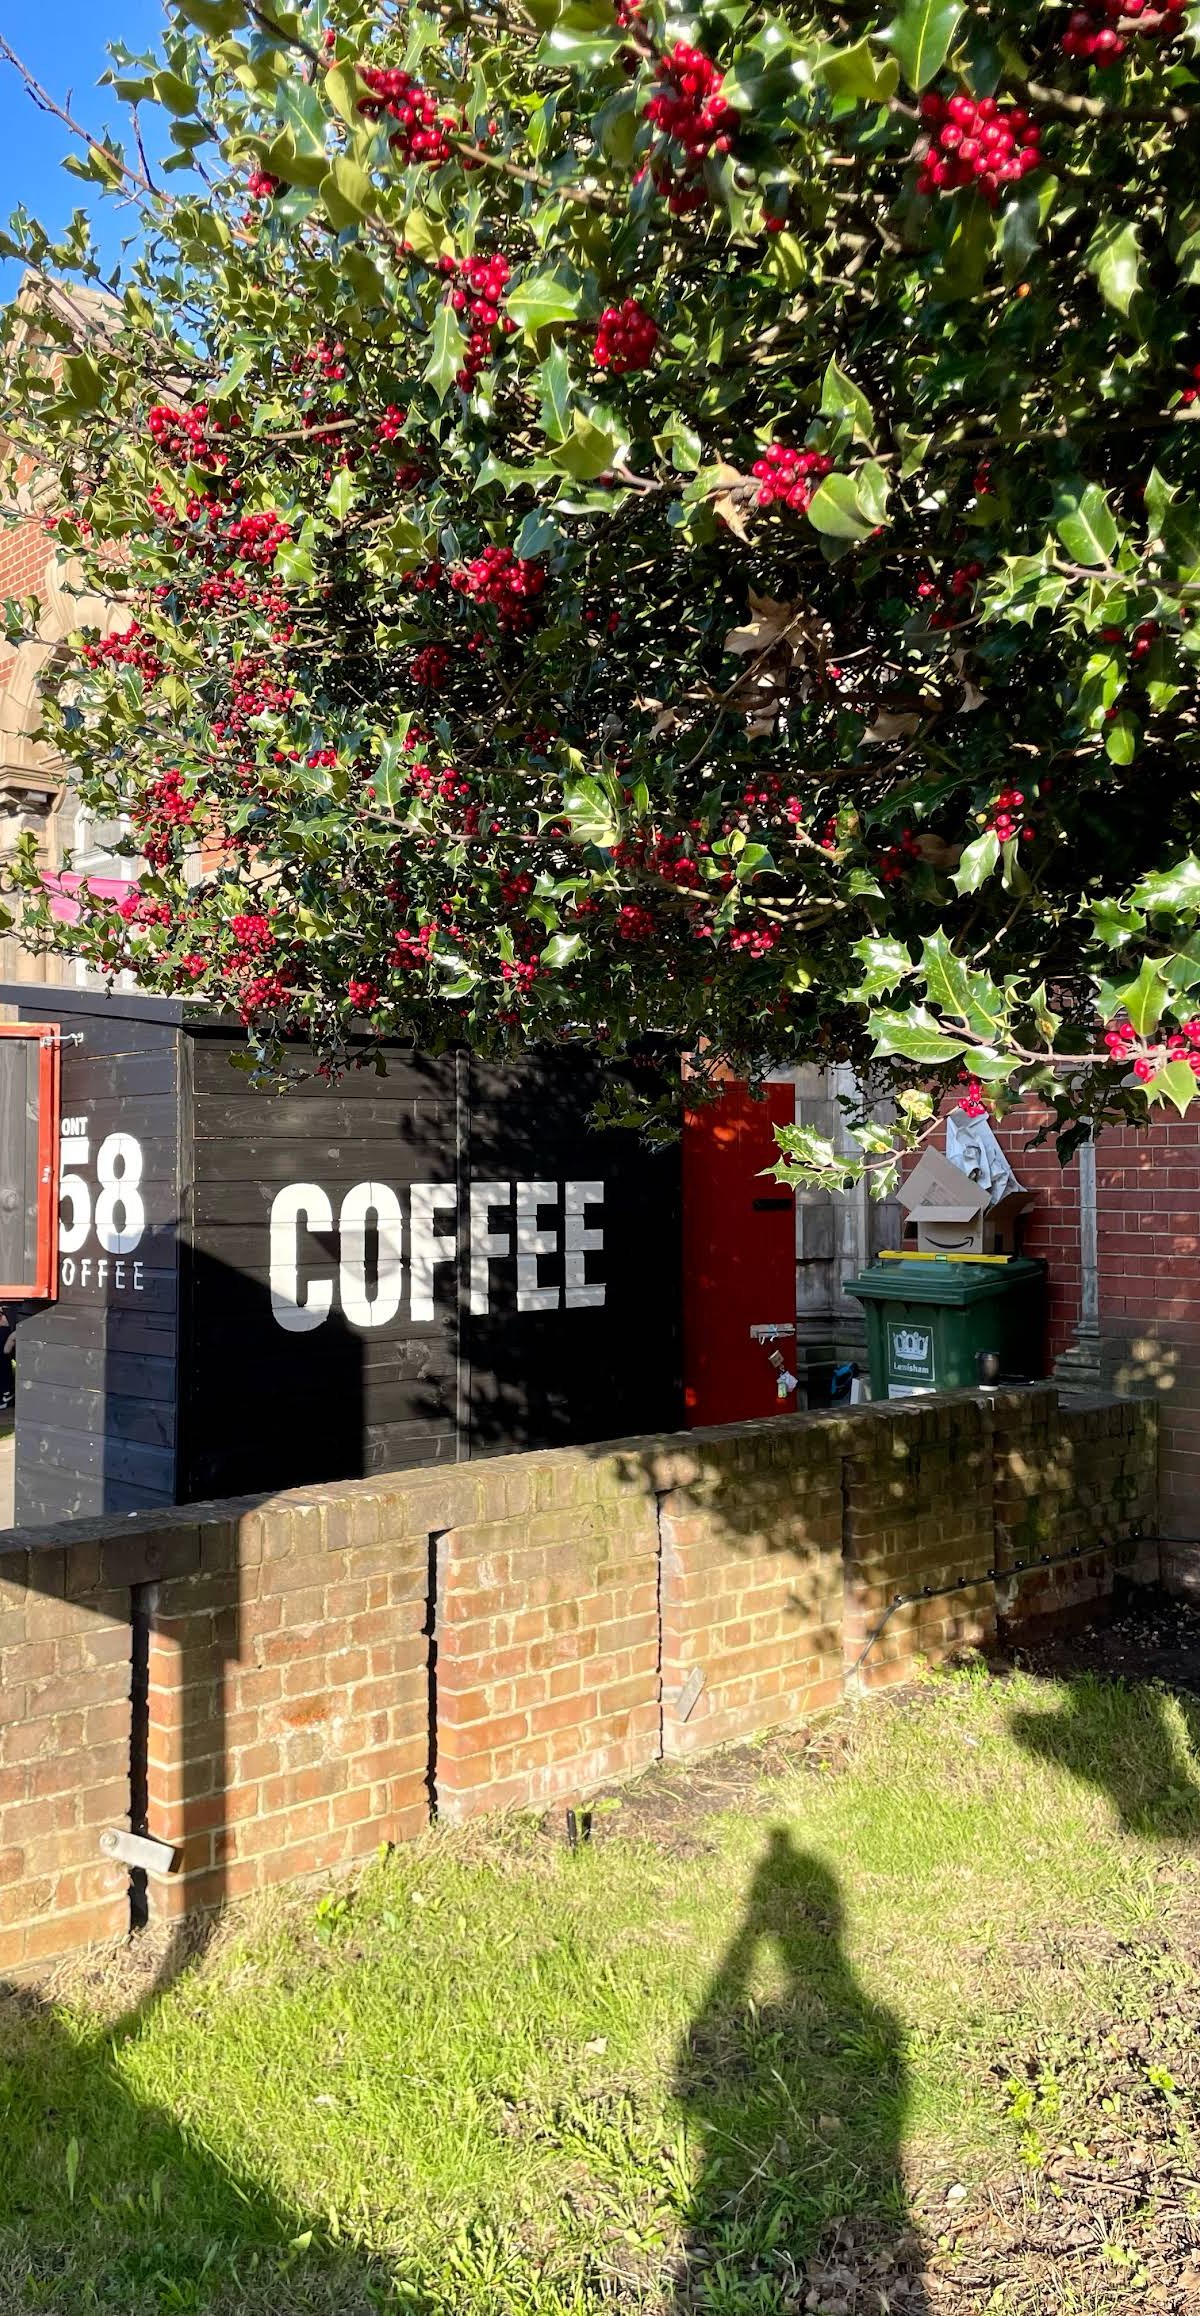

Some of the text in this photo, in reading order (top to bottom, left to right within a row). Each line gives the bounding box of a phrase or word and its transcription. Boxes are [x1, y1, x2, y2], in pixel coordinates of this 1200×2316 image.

[61, 1116, 88, 1136] ONT
[59, 1132, 145, 1255] 58
[269, 1181, 606, 1332] COFFEE
[61, 1257, 144, 1290] OFFEE
[893, 1362, 929, 1374] Lewisham
